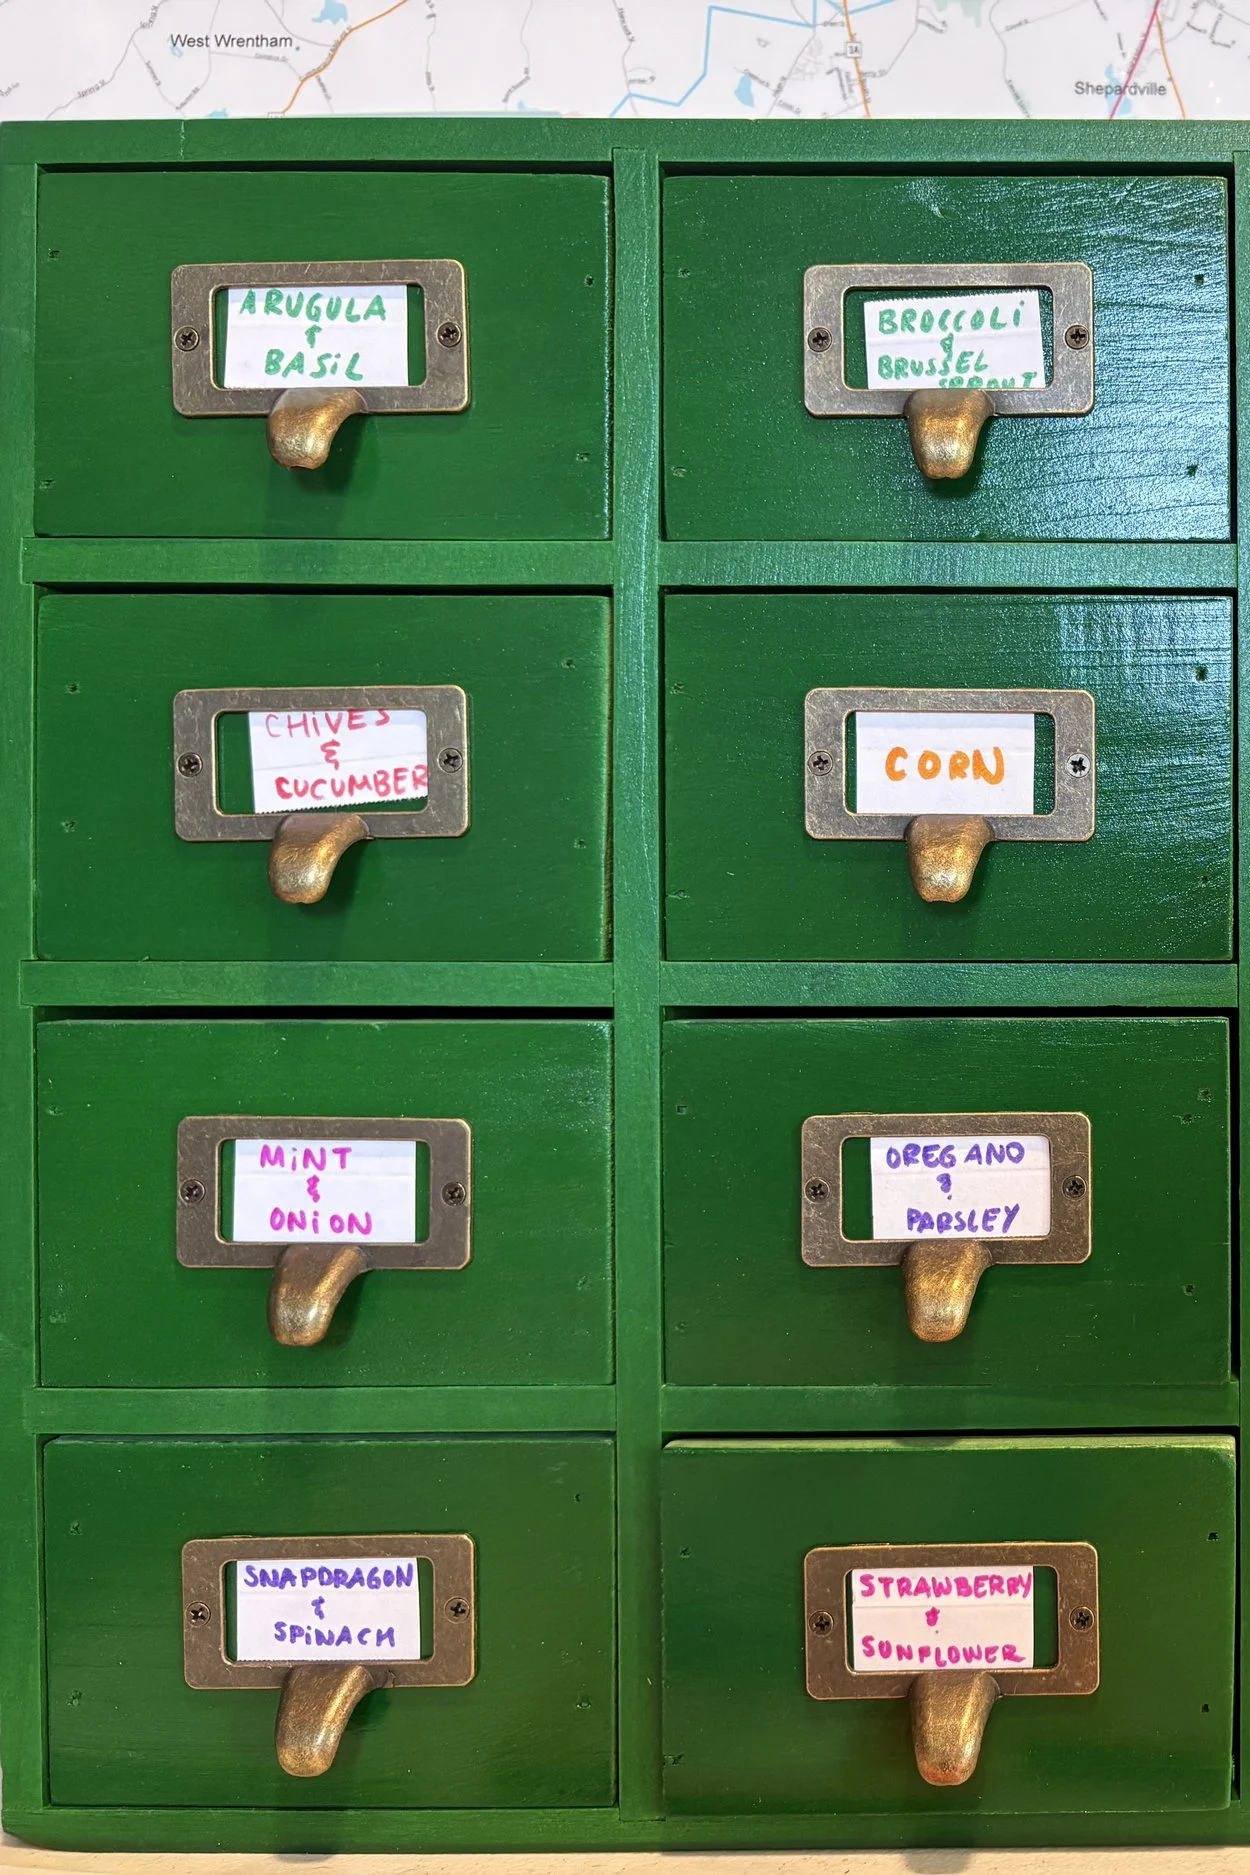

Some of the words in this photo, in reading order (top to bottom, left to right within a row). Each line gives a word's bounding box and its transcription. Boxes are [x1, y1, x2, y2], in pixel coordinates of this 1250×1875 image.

[170, 33, 210, 48] West
[214, 33, 293, 48] Wrentham
[77, 82, 100, 98] Spring
[1074, 81, 1167, 97] Shepardville
[240, 288, 387, 323] ARUGULA
[877, 350, 989, 381] BRUSSEL
[885, 746, 1005, 785] CORN
[275, 765, 428, 800] CUCUMBER
[906, 1203, 1020, 1234] PARSLEY
[244, 1563, 413, 1589] SNAPDRAGON
[859, 1572, 1032, 1598] STRAWBERRY
[861, 1635, 1026, 1668] SUNFLOWER
